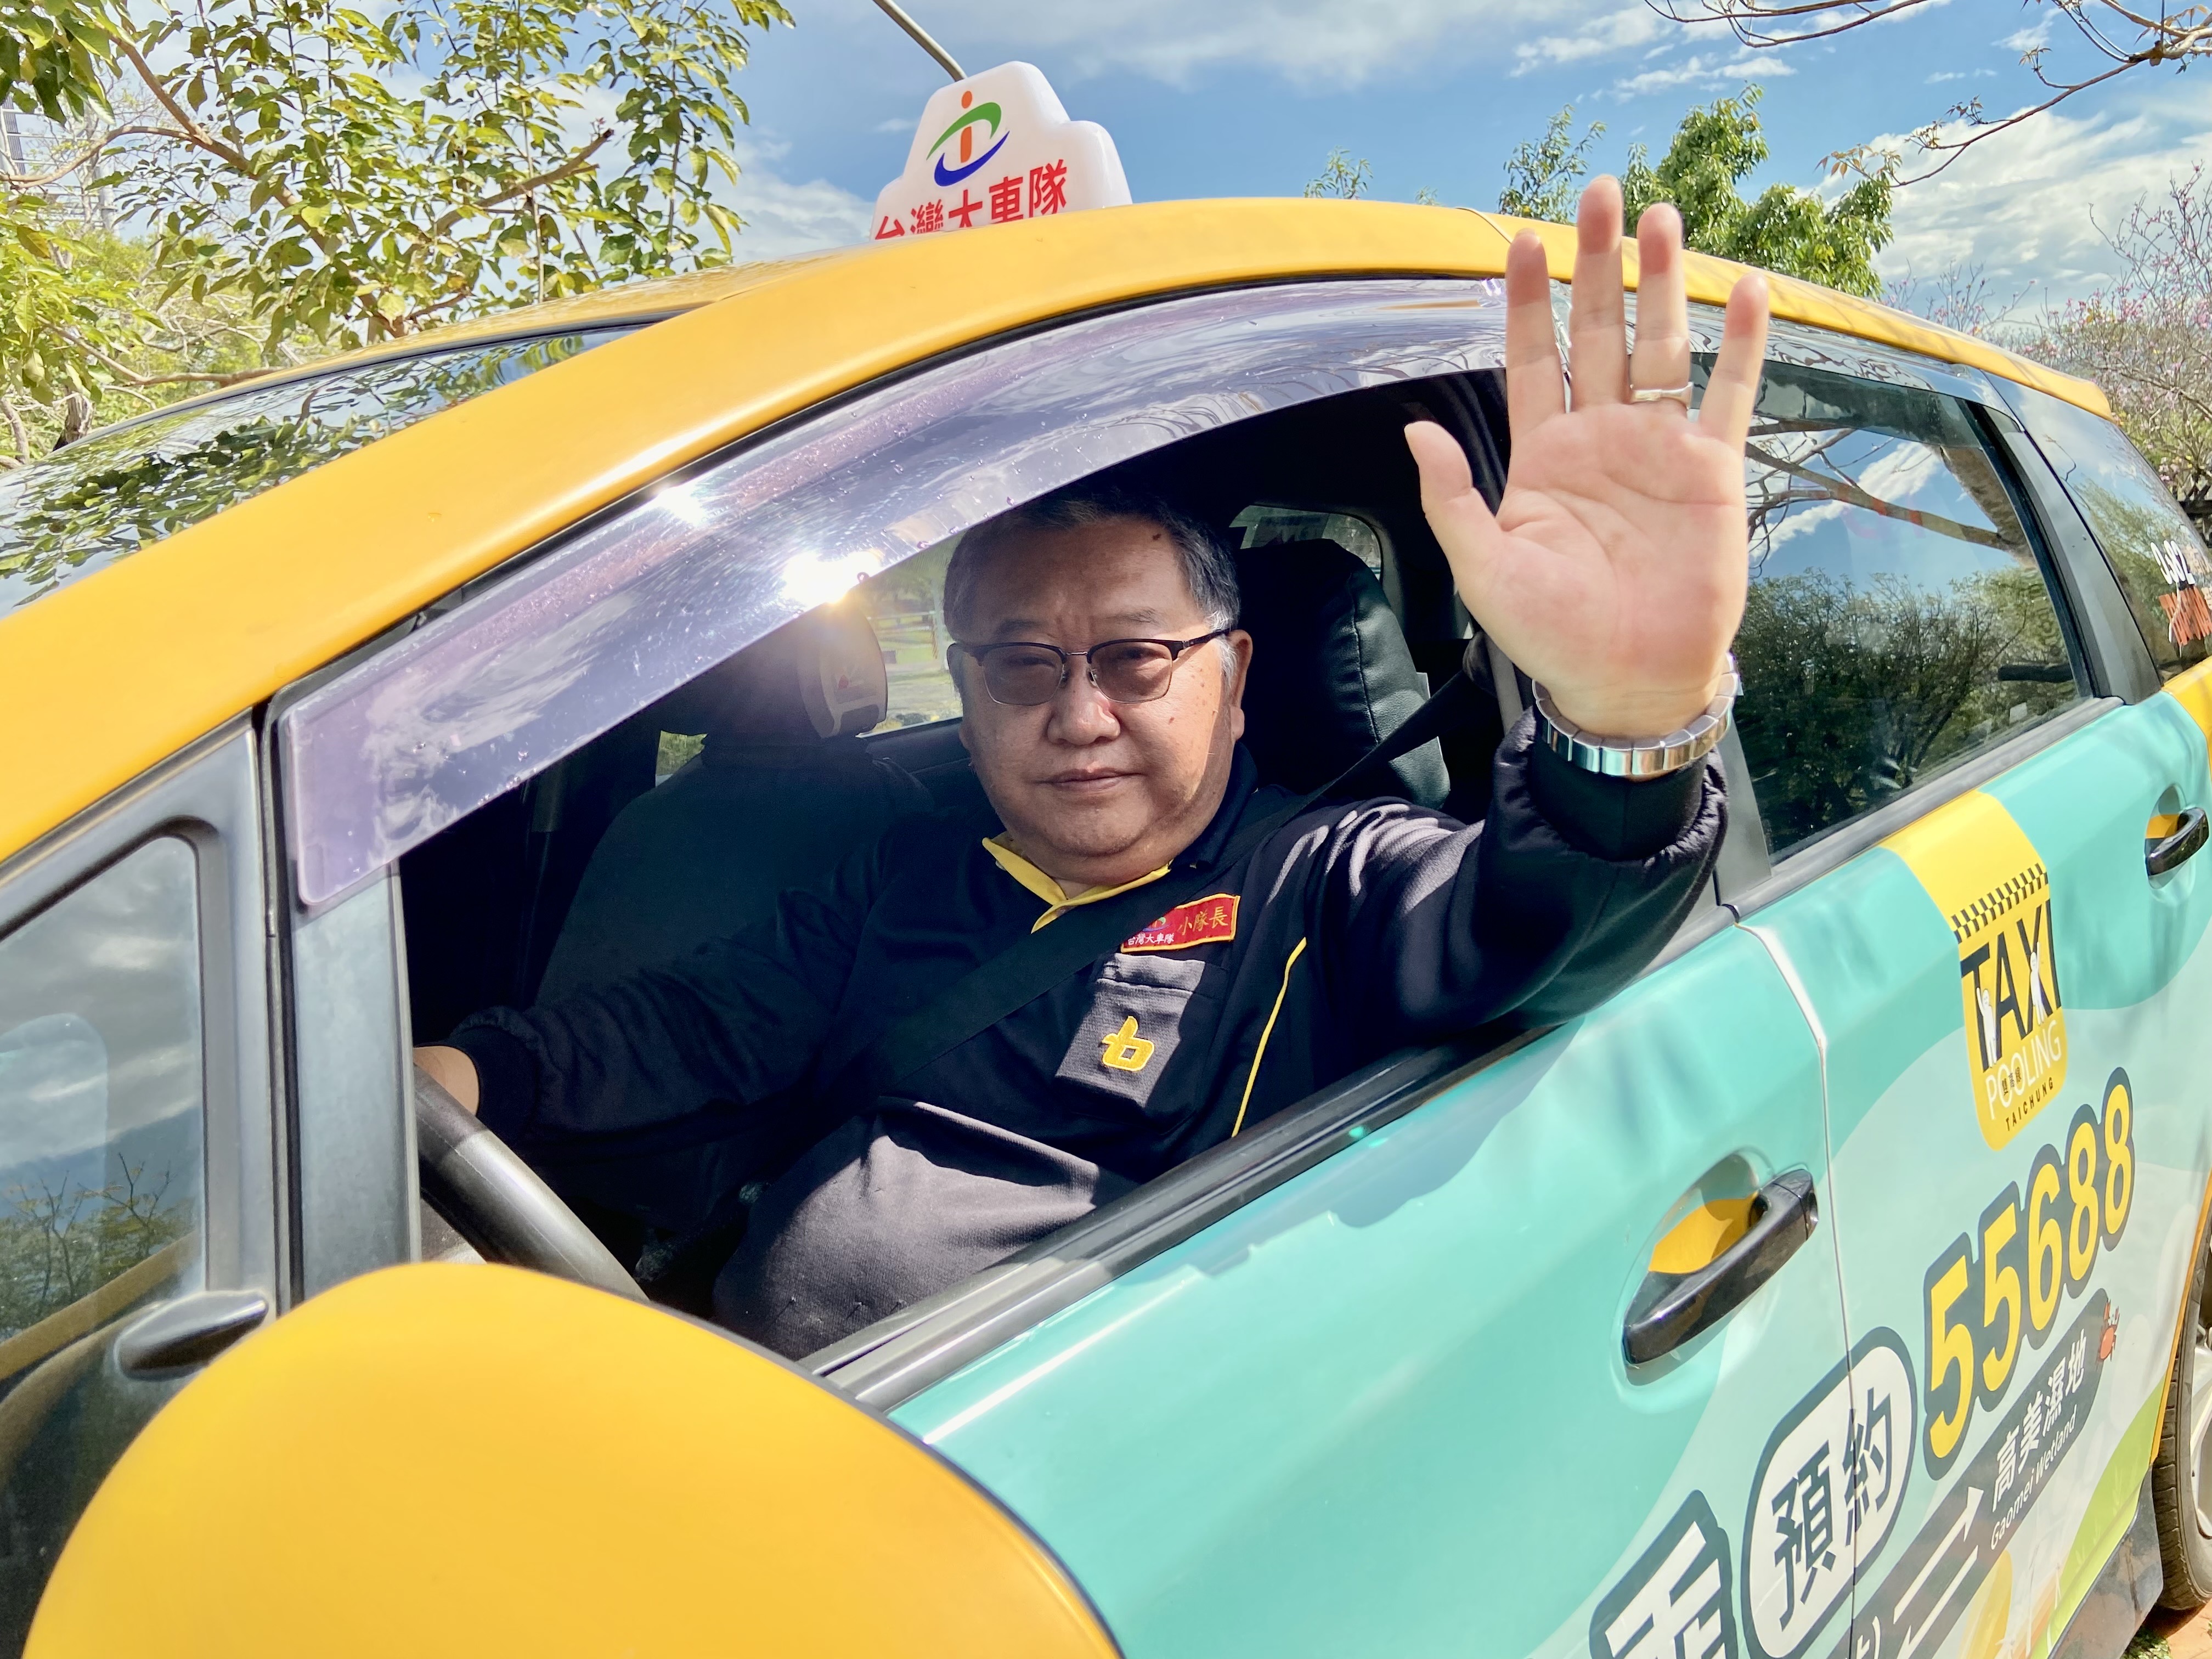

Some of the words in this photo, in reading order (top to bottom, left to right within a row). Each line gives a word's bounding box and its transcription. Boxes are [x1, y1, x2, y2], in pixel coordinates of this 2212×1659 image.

[1128, 933, 1174, 945] 台灣大車隊
[1177, 906, 1228, 935] 小隊長
[1960, 899, 2062, 1073] TAXI
[1986, 1020, 2061, 1120] POOLING
[2006, 1077, 2053, 1131] TAICHUNG
[1771, 1387, 1892, 1632] 預約
[1930, 1084, 2132, 1458] 55688
[1990, 1468, 2034, 1550] Gaomei
[2035, 1404, 2078, 1485] Wetland
[1993, 1328, 2087, 1513] 高美濕地
